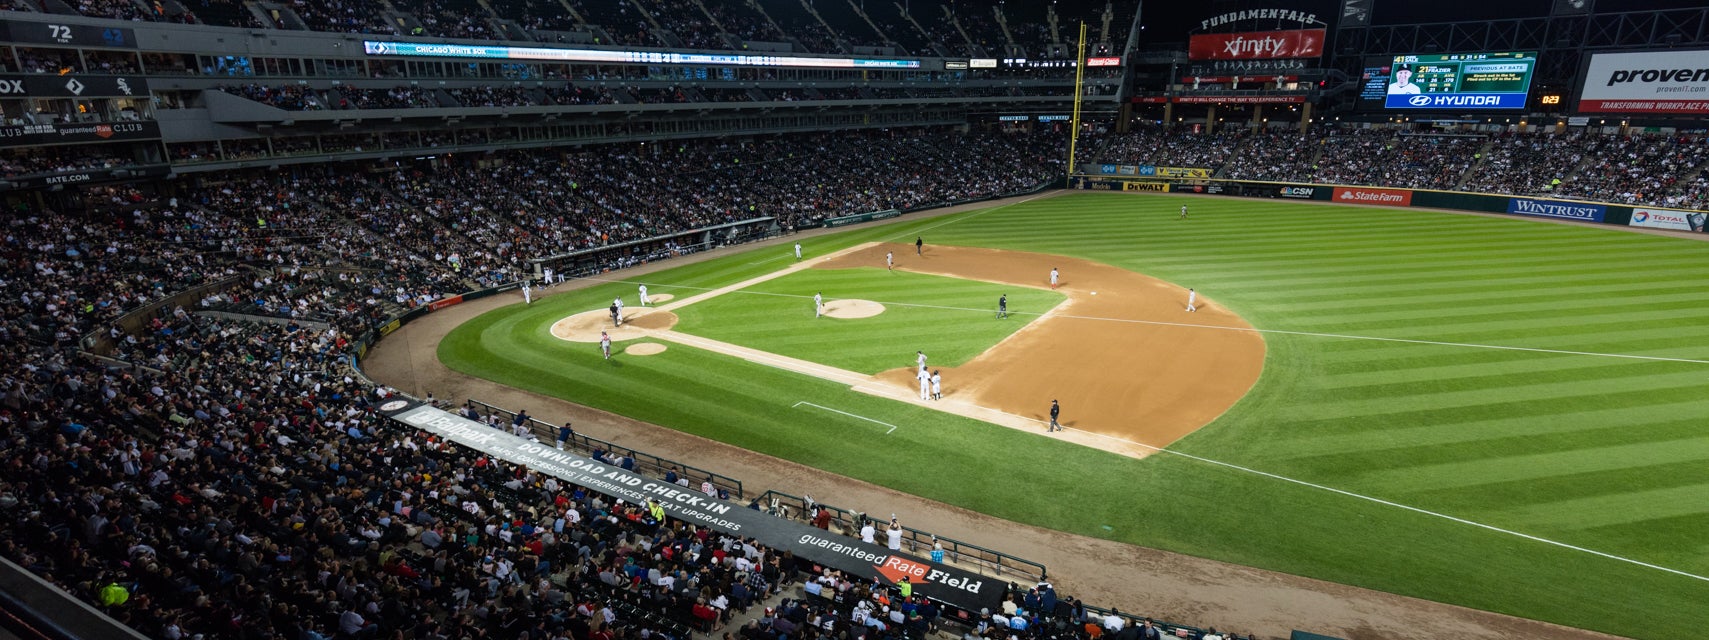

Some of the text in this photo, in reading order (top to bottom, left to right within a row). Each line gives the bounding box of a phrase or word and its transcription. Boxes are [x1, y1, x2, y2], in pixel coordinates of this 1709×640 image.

[1201, 9, 1316, 30] FUNDAMENTALS
[48, 25, 72, 38] 72
[1224, 36, 1284, 56] xfinity
[1434, 96, 1500, 105] HYUNDAI
[60, 127, 96, 135] guaranteed
[46, 174, 90, 184] RATE.COM
[1354, 192, 1403, 202] State Farm
[1516, 200, 1598, 218] WINTRUST
[427, 416, 496, 444] Ballpark
[489, 446, 514, 456] MAPS
[517, 455, 576, 476] CONCESSIONS
[580, 475, 644, 499] EXPERIENCES
[681, 508, 741, 531] UPGRADES
[518, 443, 730, 515] DOWNLOAD AND CHECK-IN
[798, 534, 982, 594] guaranteed Rate Field
